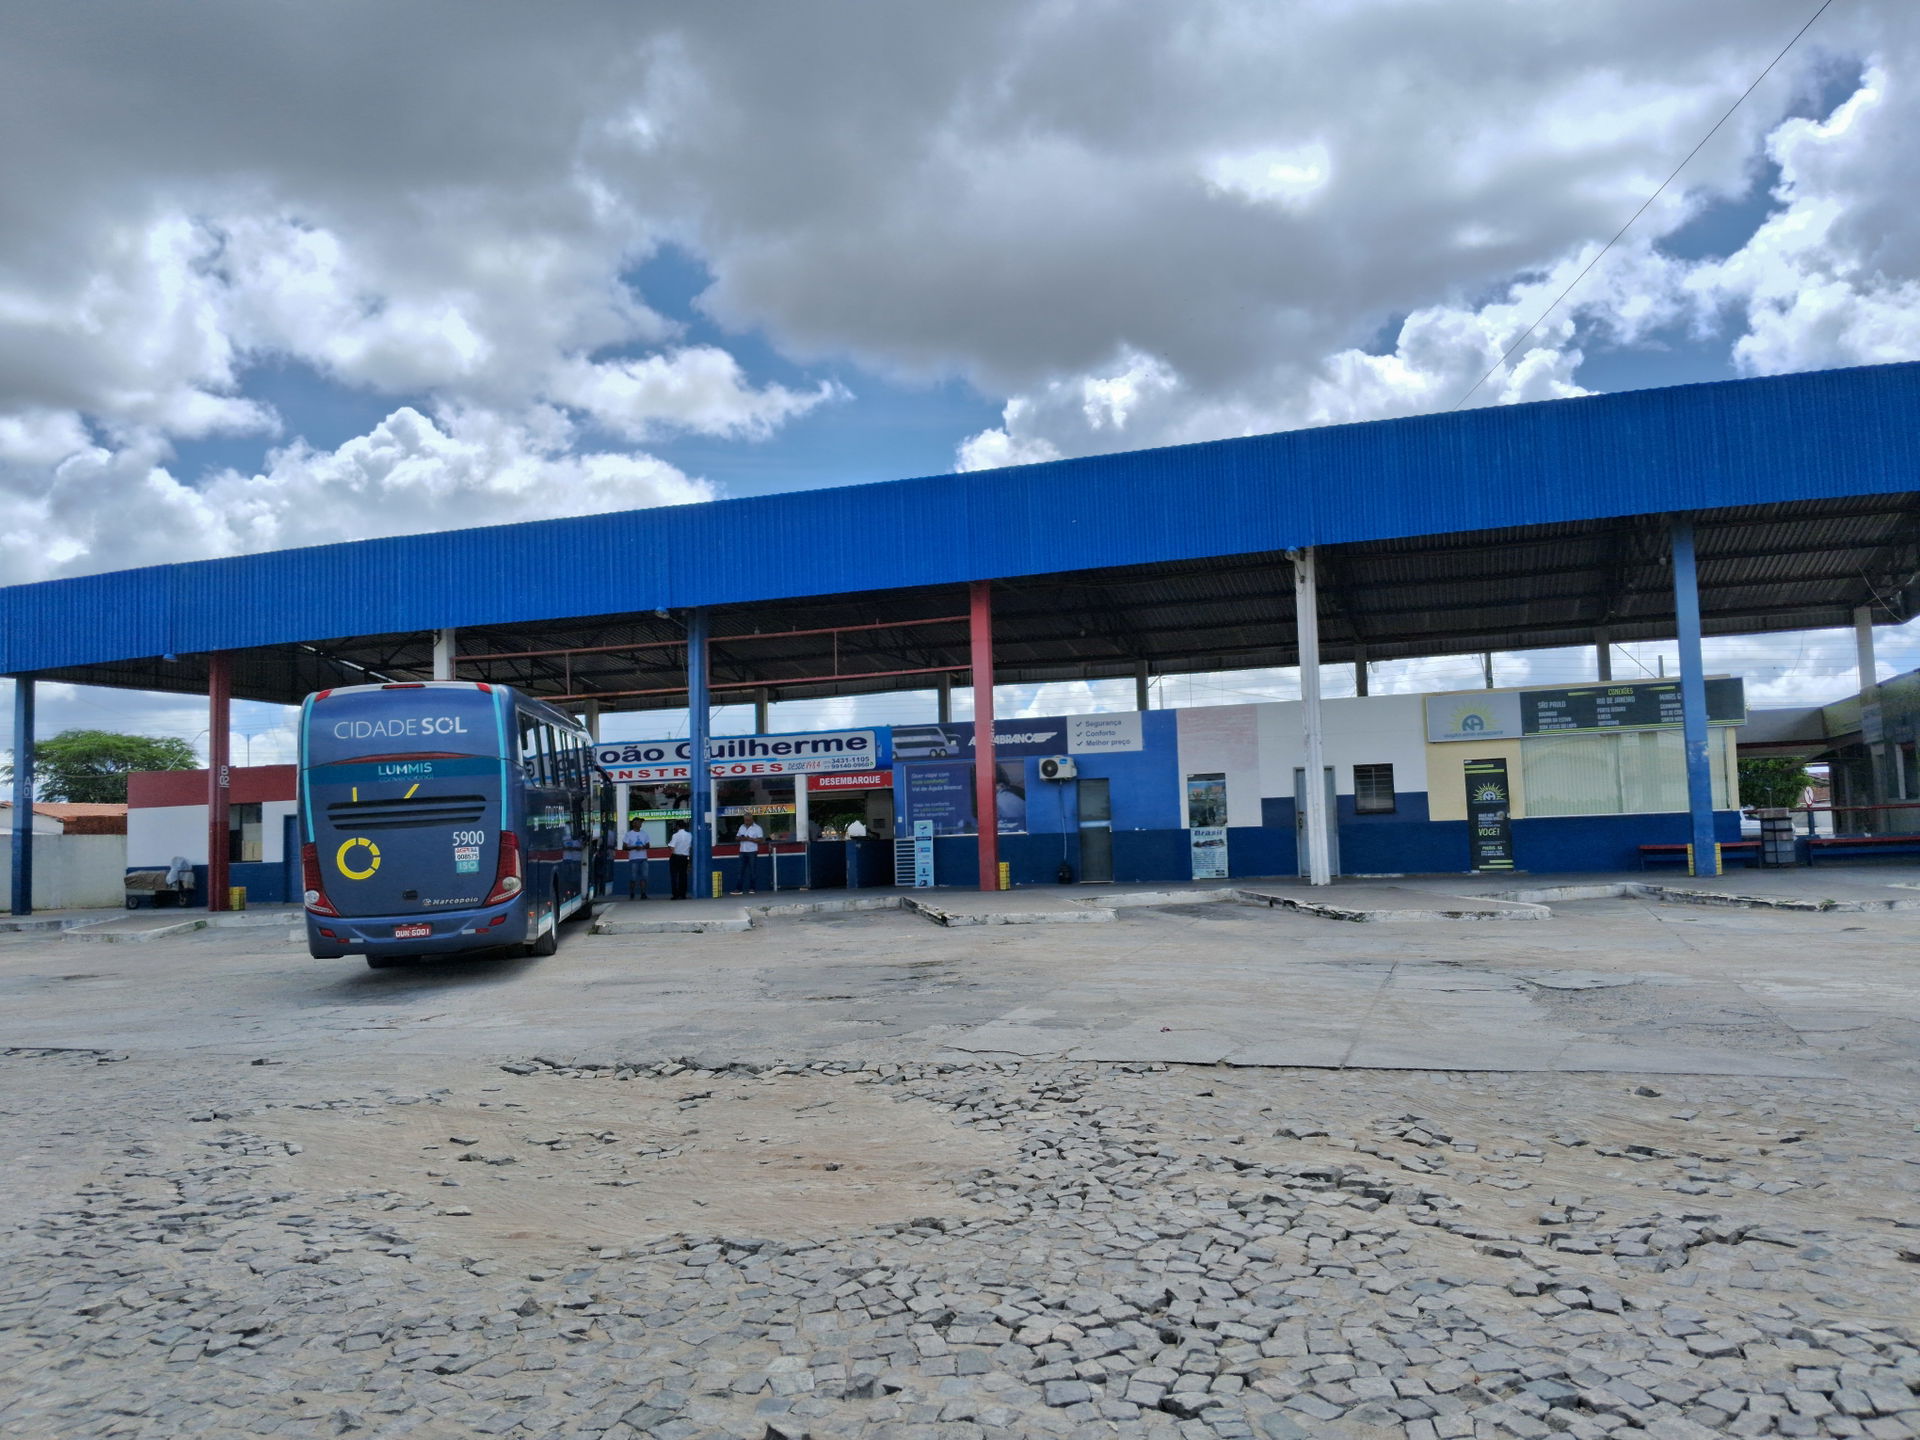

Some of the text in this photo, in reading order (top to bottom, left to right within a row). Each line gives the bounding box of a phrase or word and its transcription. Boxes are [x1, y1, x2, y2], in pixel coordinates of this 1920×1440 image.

[334, 717, 468, 739] CIDADE SOL
[1085, 729, 1117, 737] Conforto
[594, 745, 665, 764] oão
[378, 763, 433, 775] LUMMIS
[820, 776, 881, 786] DESEMBARQUE
[452, 830, 485, 846] 5900
[432, 897, 479, 906] Marcopolo
